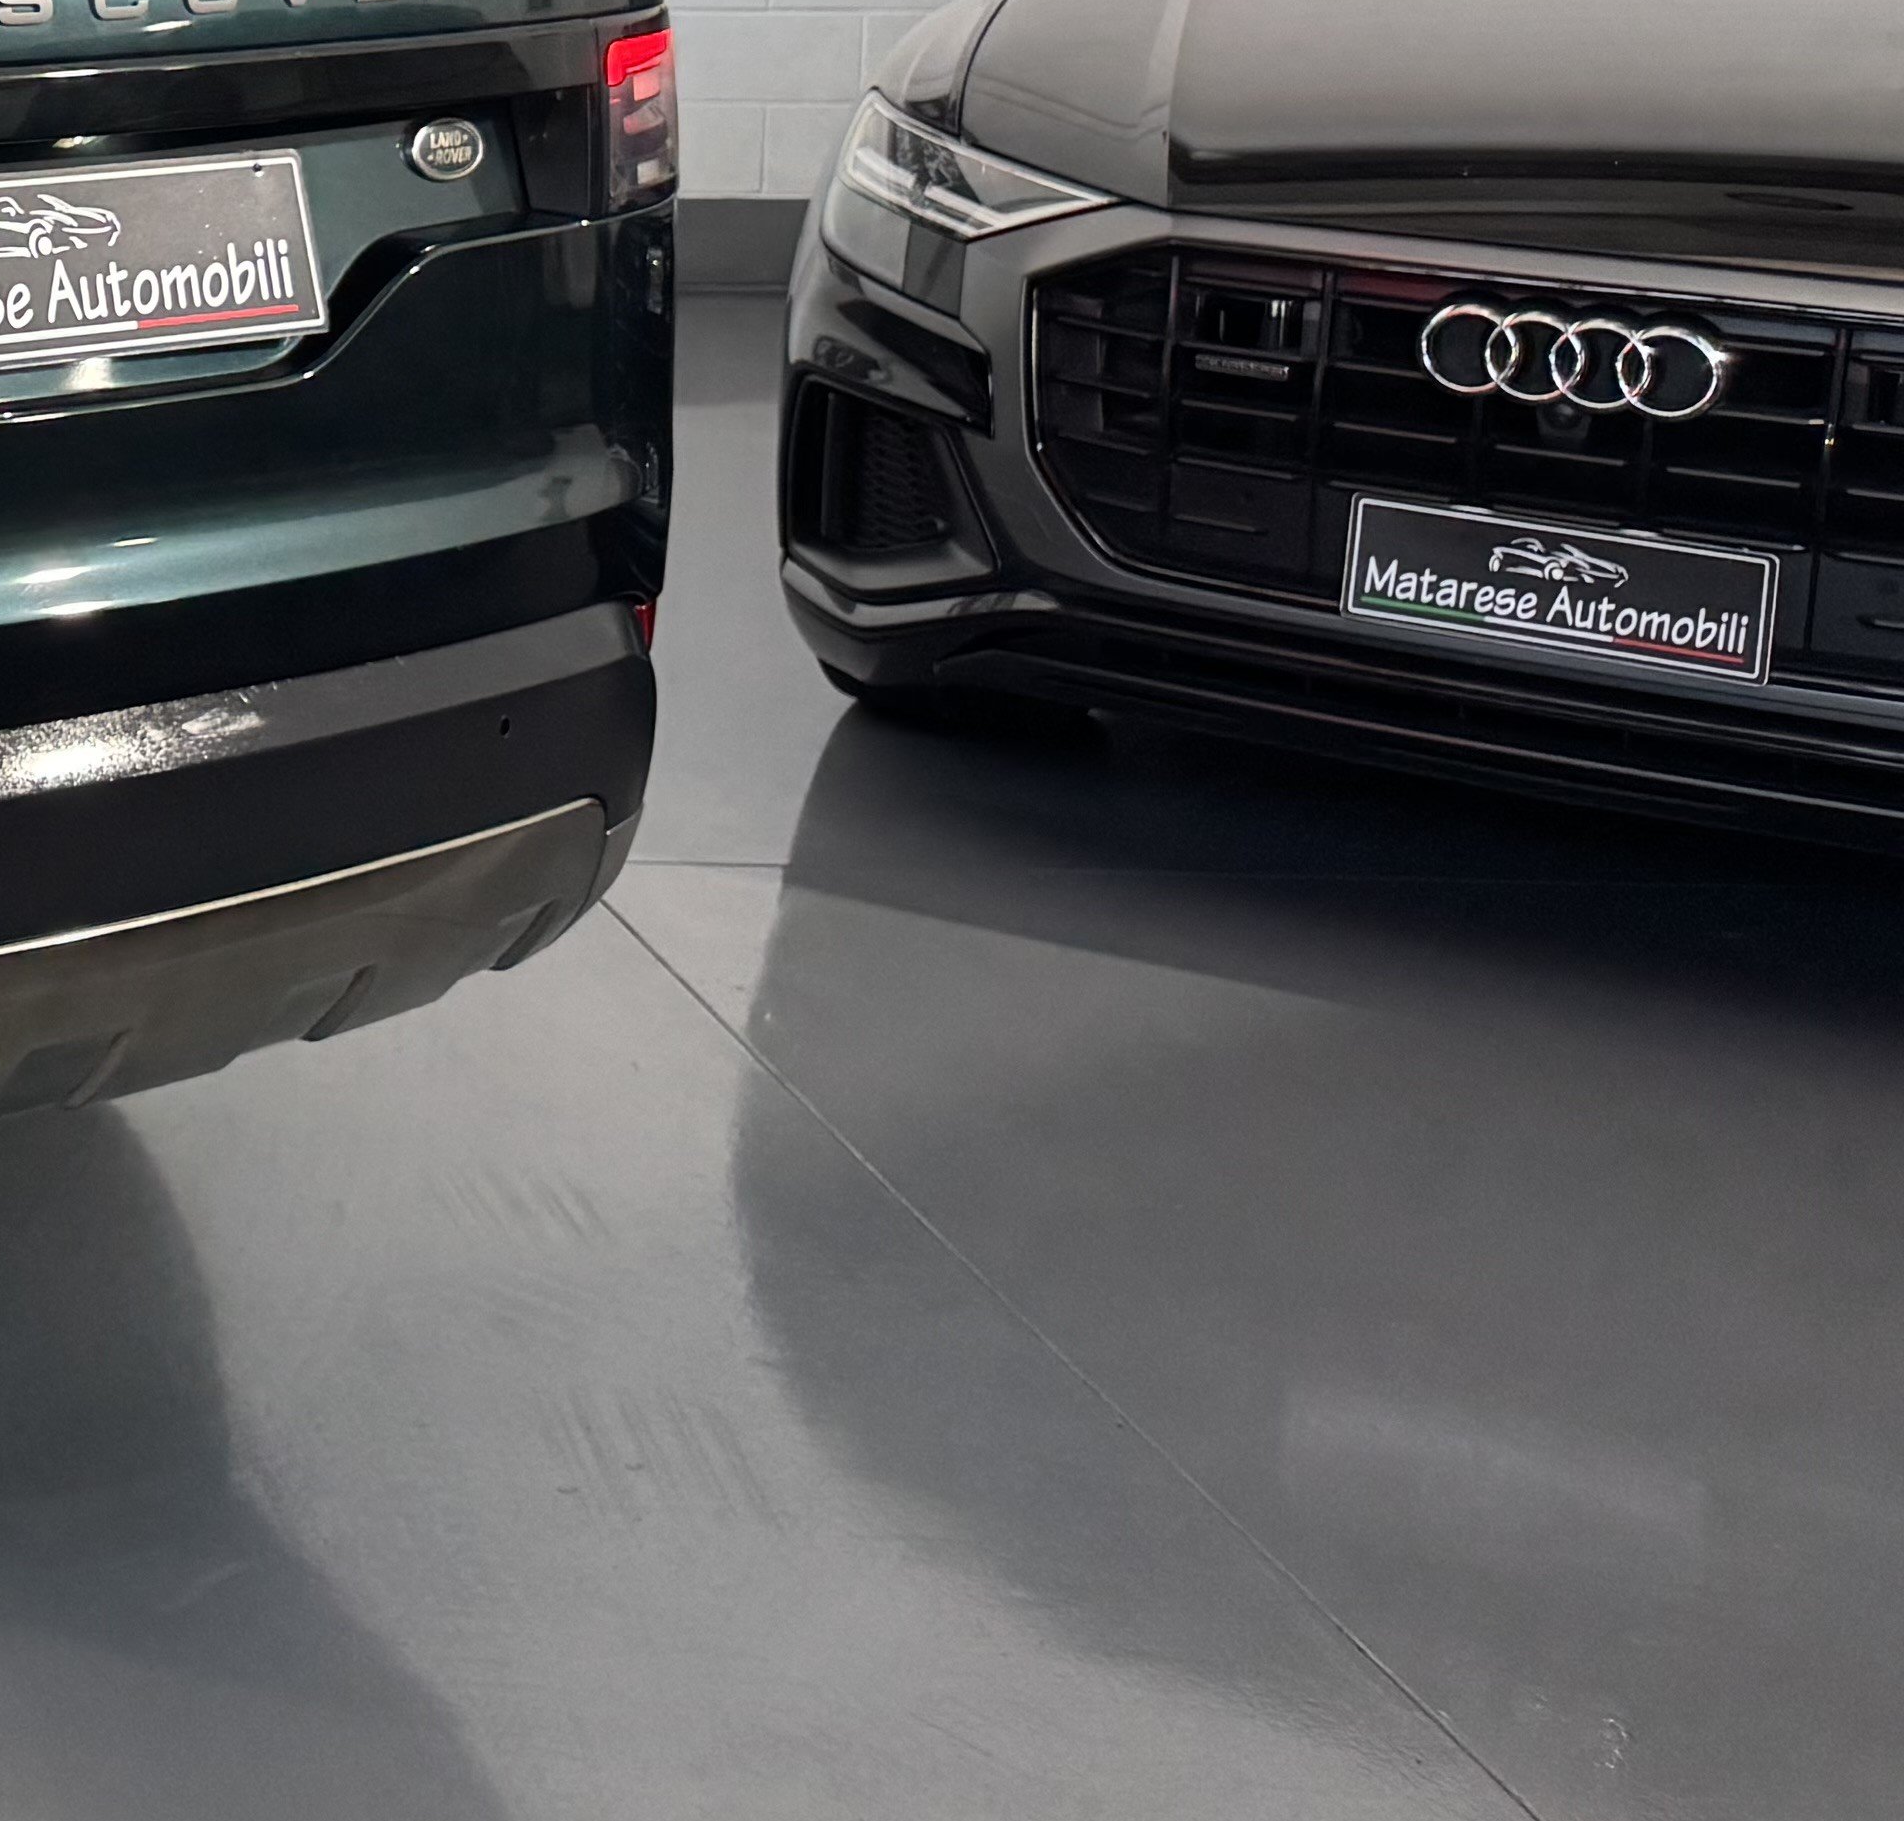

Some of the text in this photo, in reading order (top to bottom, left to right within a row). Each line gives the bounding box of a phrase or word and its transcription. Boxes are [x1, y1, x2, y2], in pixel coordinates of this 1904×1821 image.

[430, 130, 462, 148] LAND
[47, 236, 296, 325] Automobili
[1363, 554, 1750, 655] Matarese Automobili
